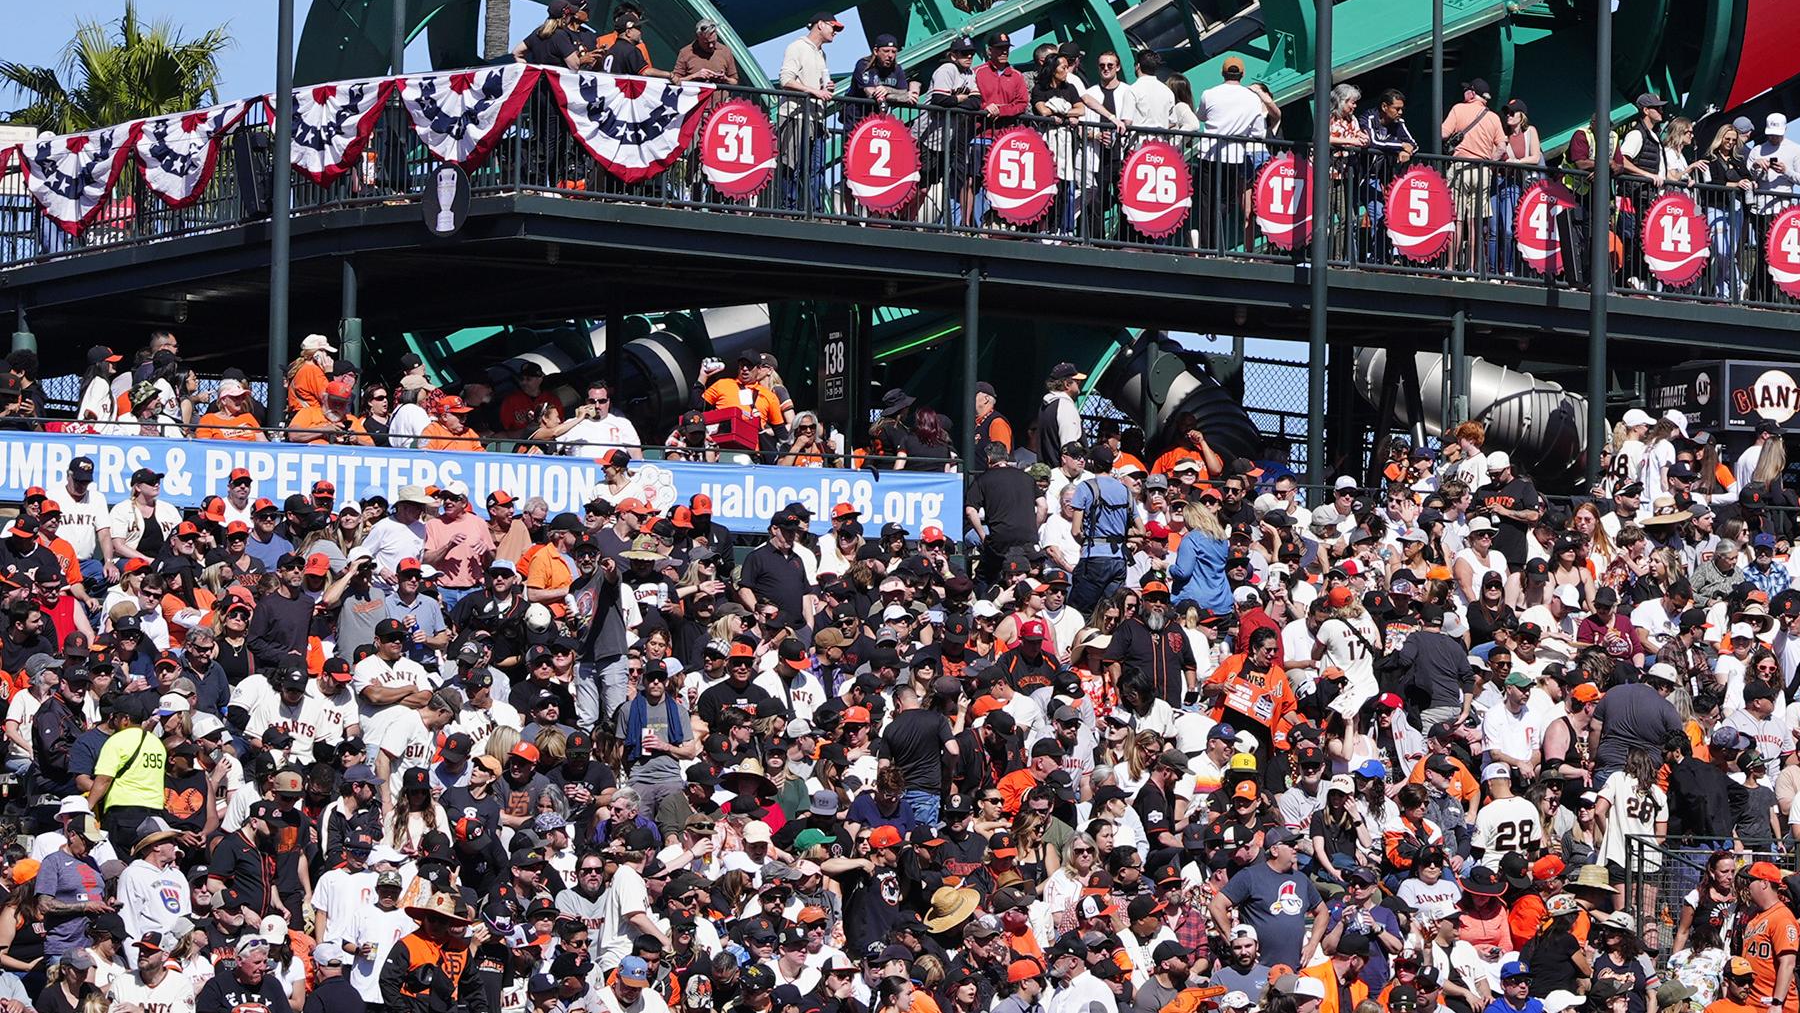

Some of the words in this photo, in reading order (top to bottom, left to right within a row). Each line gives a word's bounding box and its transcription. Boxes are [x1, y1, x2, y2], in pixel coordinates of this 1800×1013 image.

[604, 54, 614, 73] 9
[727, 112, 748, 125] Enjoy
[872, 127, 891, 138] Enjoy
[717, 124, 754, 165] 31
[870, 139, 891, 177] 2
[1010, 139, 1029, 150] Enjoy
[999, 150, 1036, 190] 51
[1146, 154, 1163, 165] Enjoy
[1135, 164, 1177, 204] 26
[1269, 176, 1304, 215] 17
[1411, 178, 1428, 189] Enjoy
[1409, 190, 1429, 227] 5
[1667, 205, 1683, 216] Enjoy
[1660, 215, 1692, 253] 14
[824, 342, 844, 375] 138
[163, 447, 193, 496] &
[474, 462, 596, 513] UNION
[1348, 640, 1367, 661] 17
[143, 752, 163, 769] 395
[1627, 796, 1654, 824] 28
[1495, 819, 1535, 852] 28
[1747, 940, 1769, 959] 40
